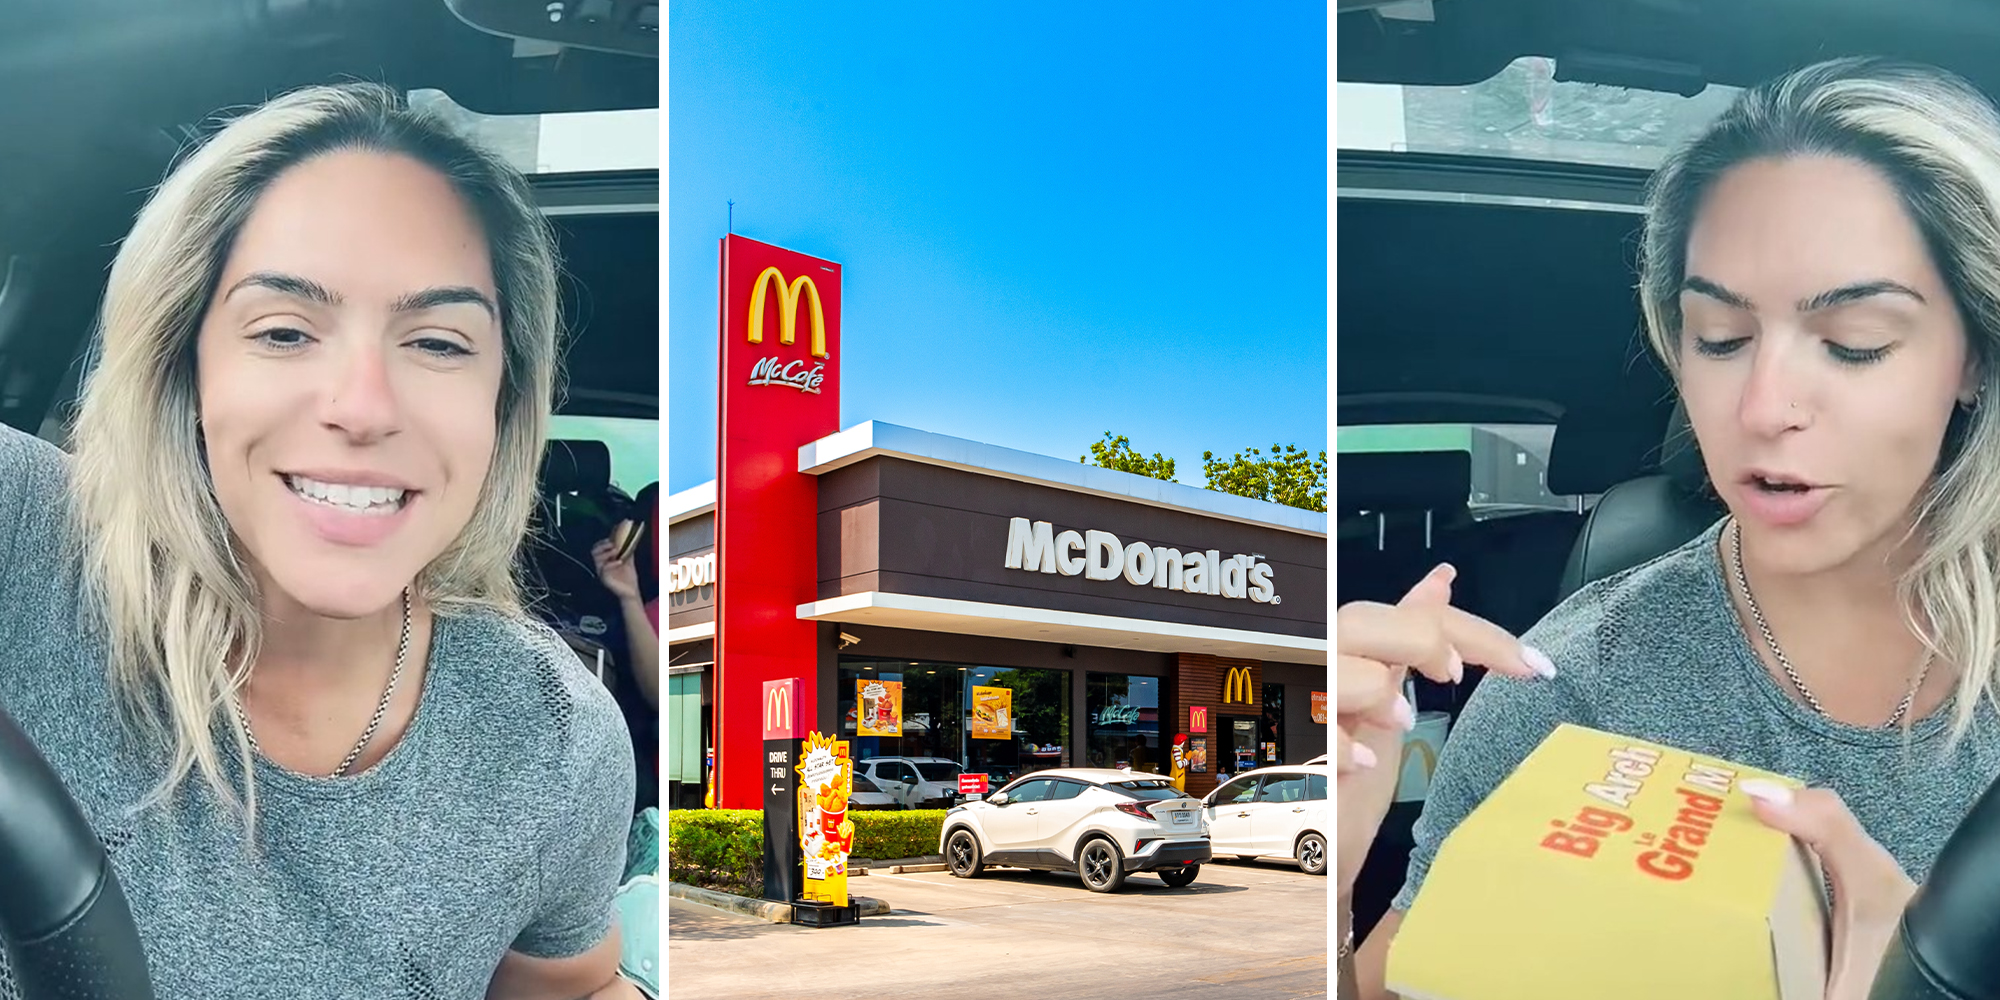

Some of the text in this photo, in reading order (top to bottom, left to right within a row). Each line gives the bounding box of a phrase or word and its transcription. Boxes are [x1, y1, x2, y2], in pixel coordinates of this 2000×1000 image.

[1004, 516, 1275, 603] McDonald's
[769, 751, 788, 763] DRIVE
[770, 767, 786, 778] THRU
[1540, 745, 1663, 860] Big Arch
[1636, 788, 1725, 882] Grand
